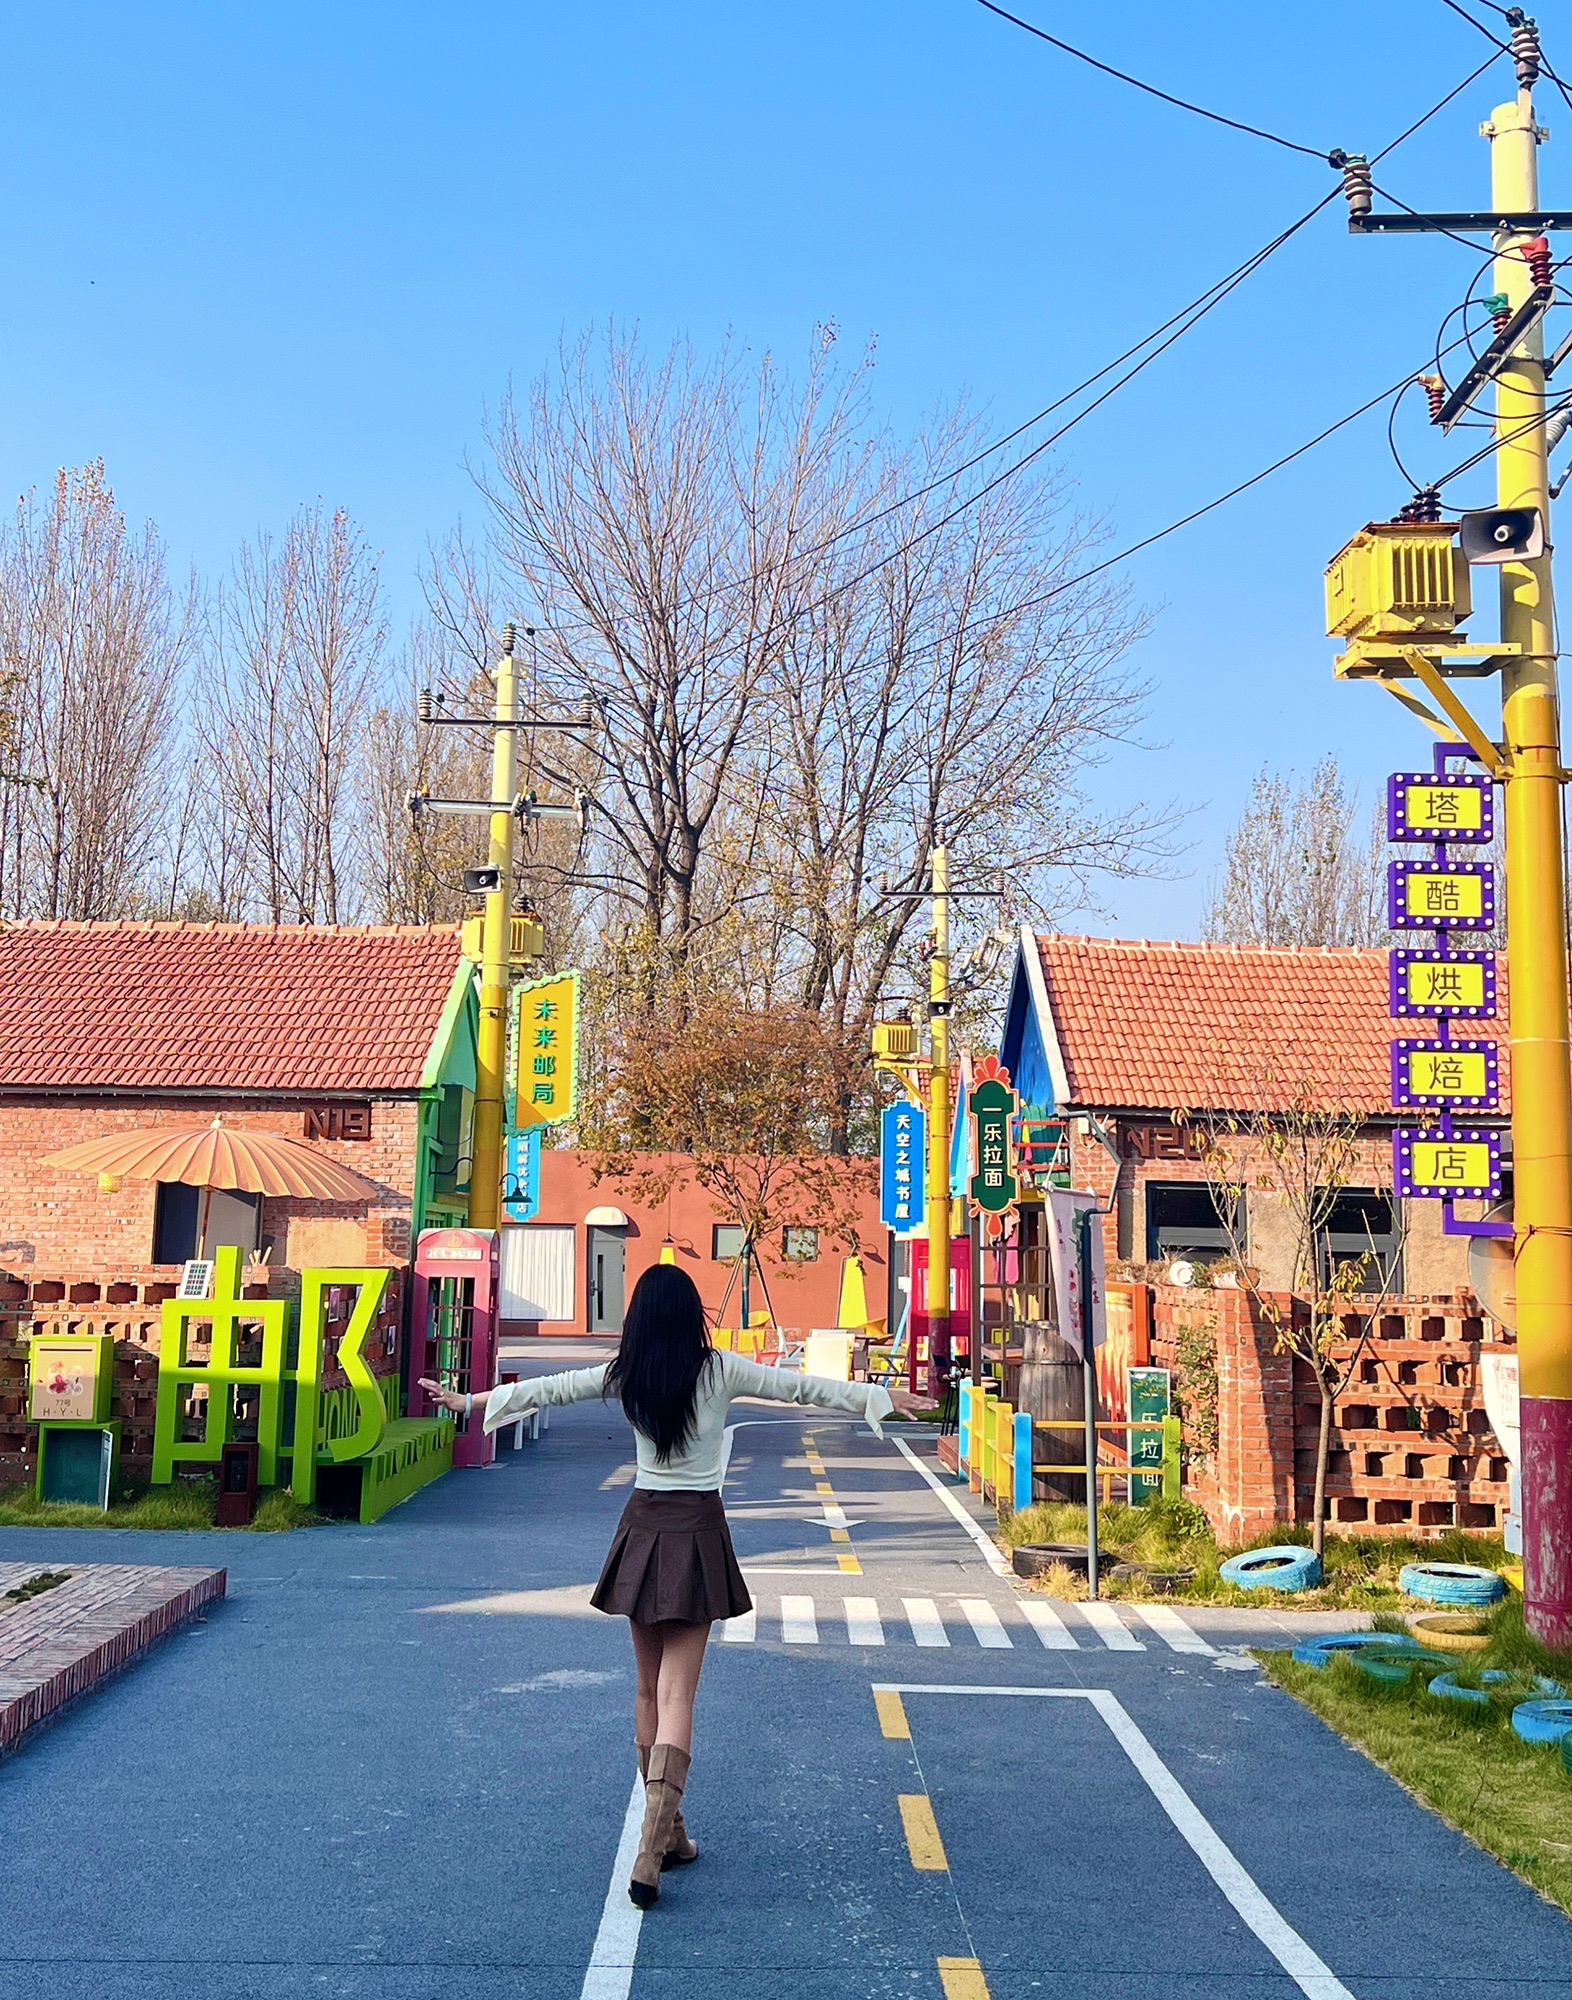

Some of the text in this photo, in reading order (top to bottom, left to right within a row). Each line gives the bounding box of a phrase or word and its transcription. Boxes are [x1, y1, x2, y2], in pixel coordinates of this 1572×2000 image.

[1426, 791, 1467, 1181] 塔酷烘焙店
[532, 998, 557, 1104] 未来邮局
[304, 1108, 369, 1138] N19
[895, 1114, 912, 1219] 天空之城书屋
[982, 1107, 1003, 1187] 一乐拉面
[151, 1246, 392, 1504] 邮
